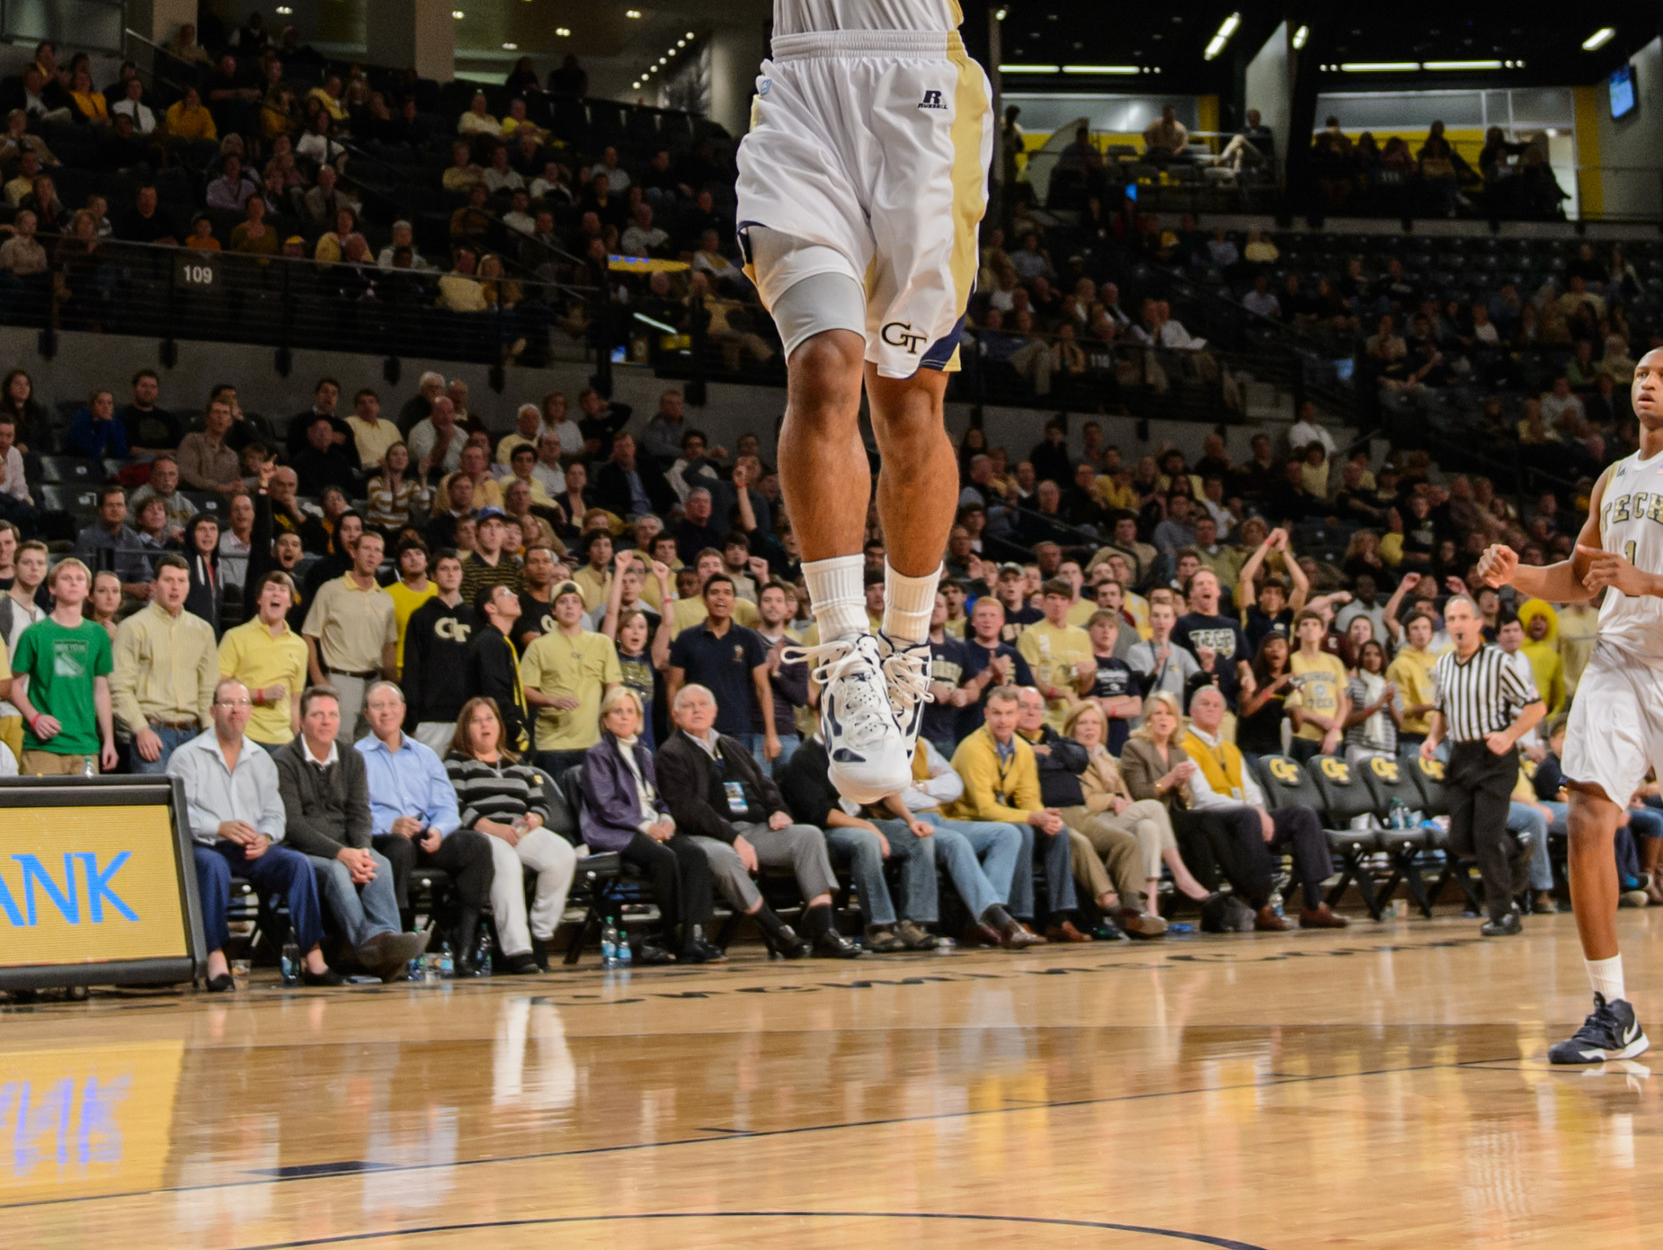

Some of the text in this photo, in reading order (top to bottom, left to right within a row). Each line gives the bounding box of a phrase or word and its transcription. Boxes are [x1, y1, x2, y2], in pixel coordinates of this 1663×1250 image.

[183, 265, 212, 284] 109
[881, 321, 928, 354] GT
[434, 616, 471, 643] GT
[1270, 758, 1299, 782] GT
[1321, 758, 1350, 784] GT
[1371, 757, 1399, 783] GT
